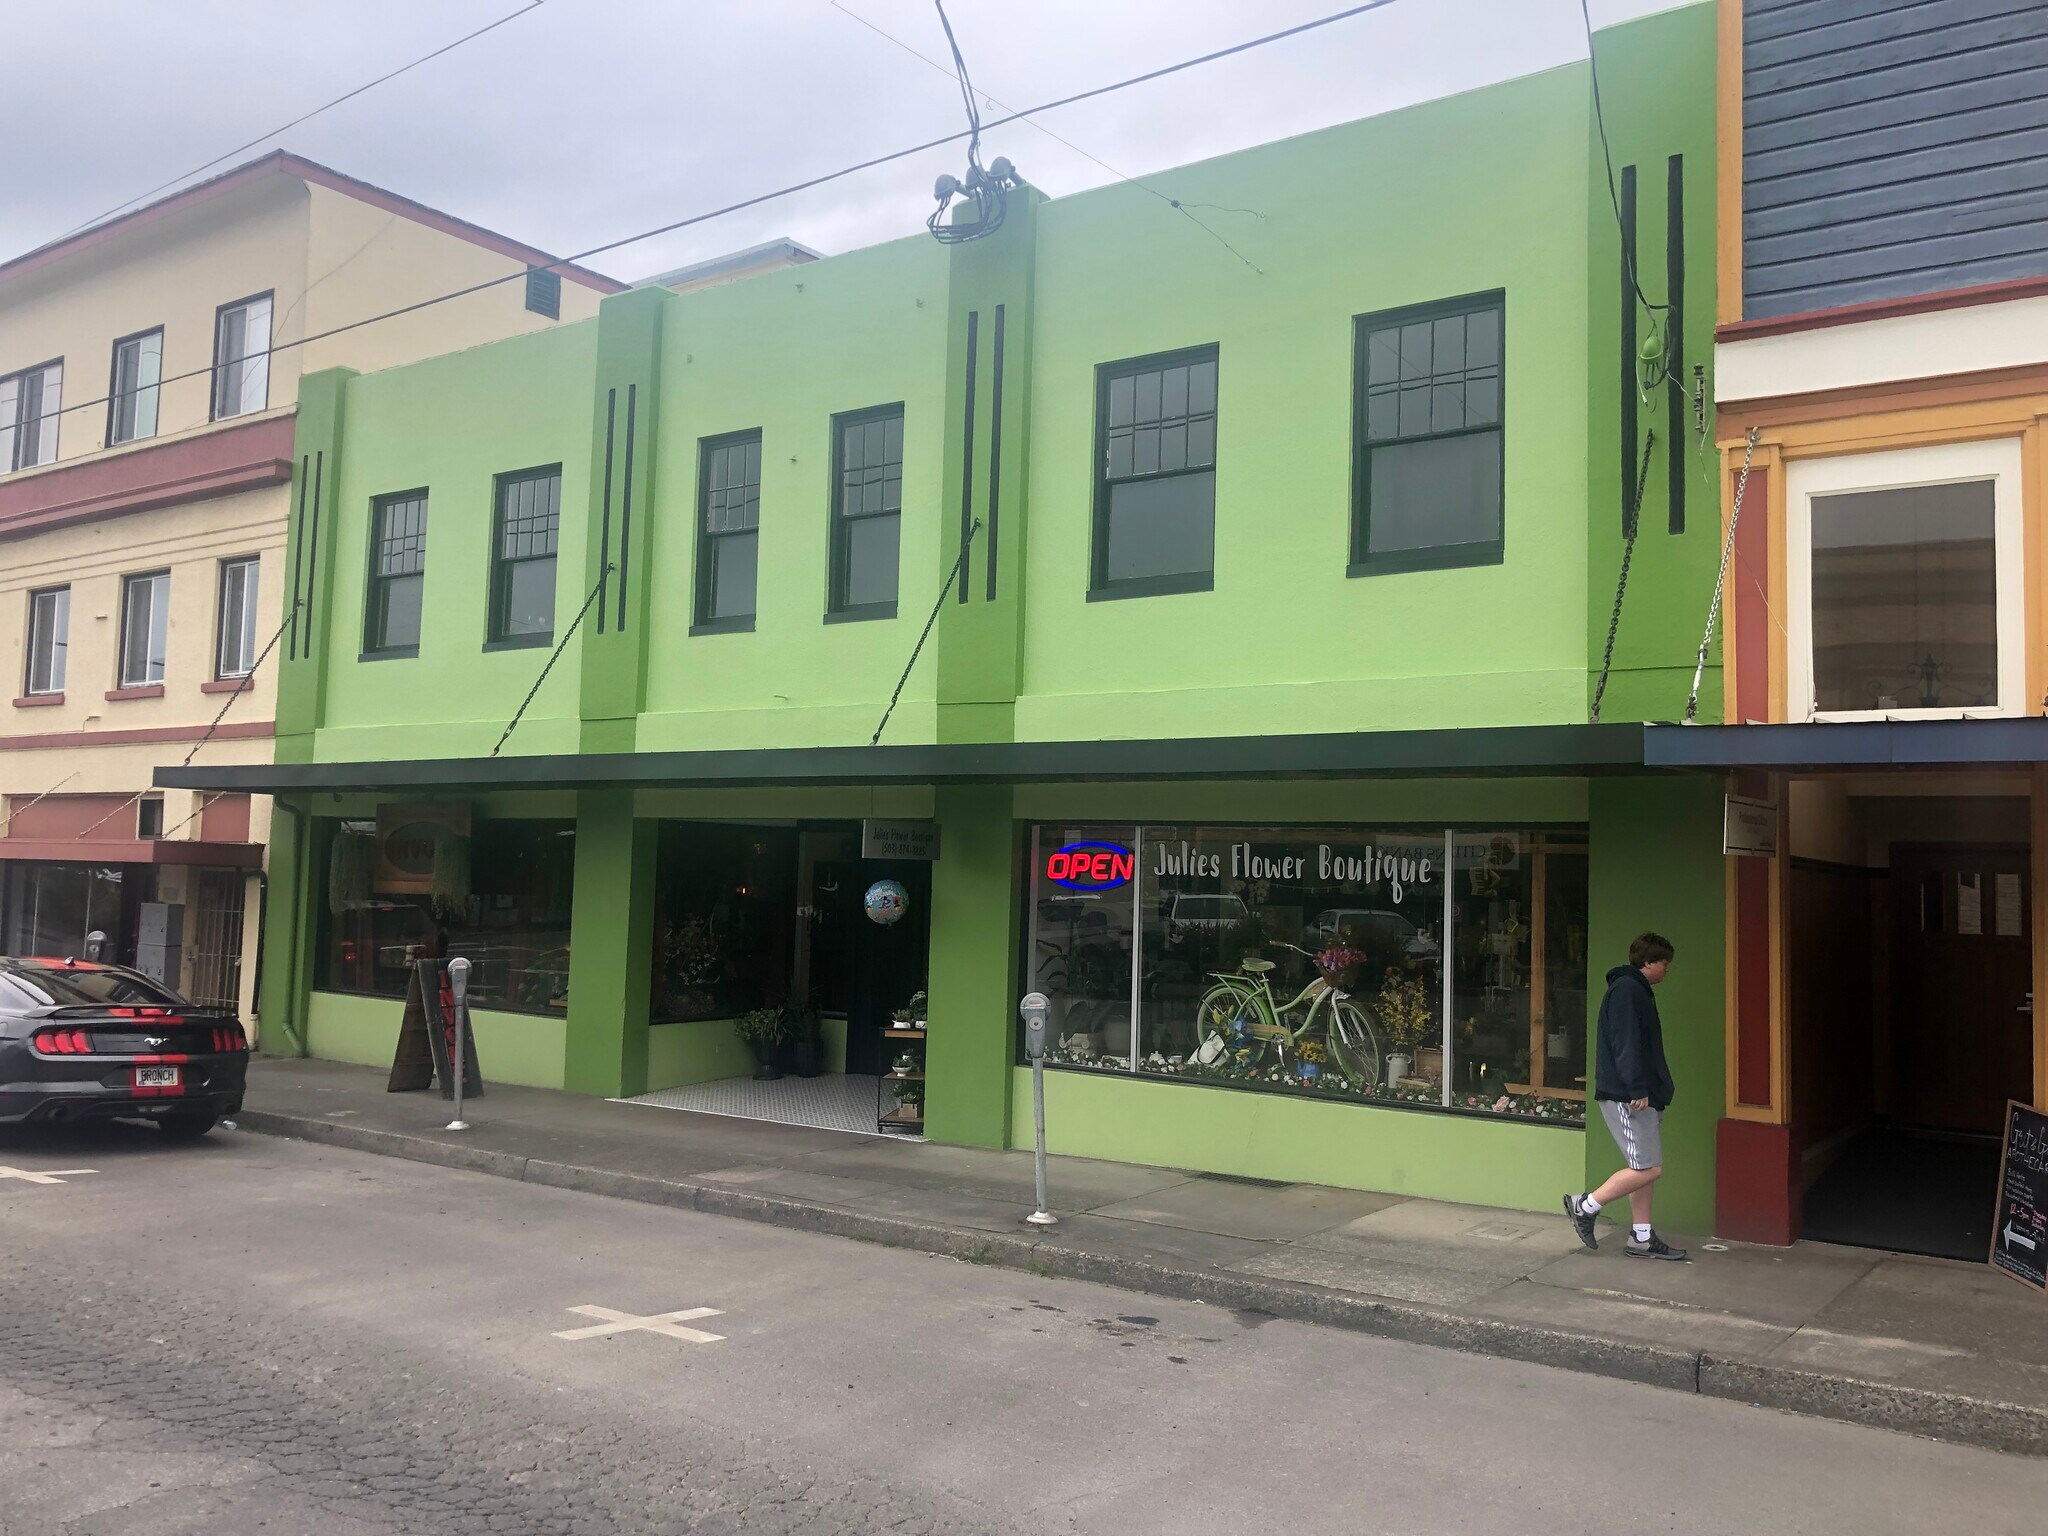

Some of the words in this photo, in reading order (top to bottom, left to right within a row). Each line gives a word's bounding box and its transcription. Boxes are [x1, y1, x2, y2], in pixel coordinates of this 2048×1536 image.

[1047, 853, 1134, 880] OPEN
[1154, 841, 1220, 877] Julies
[1231, 841, 1306, 880] Flower
[1318, 844, 1431, 904] Boutique
[141, 1070, 174, 1081] BRONCH
